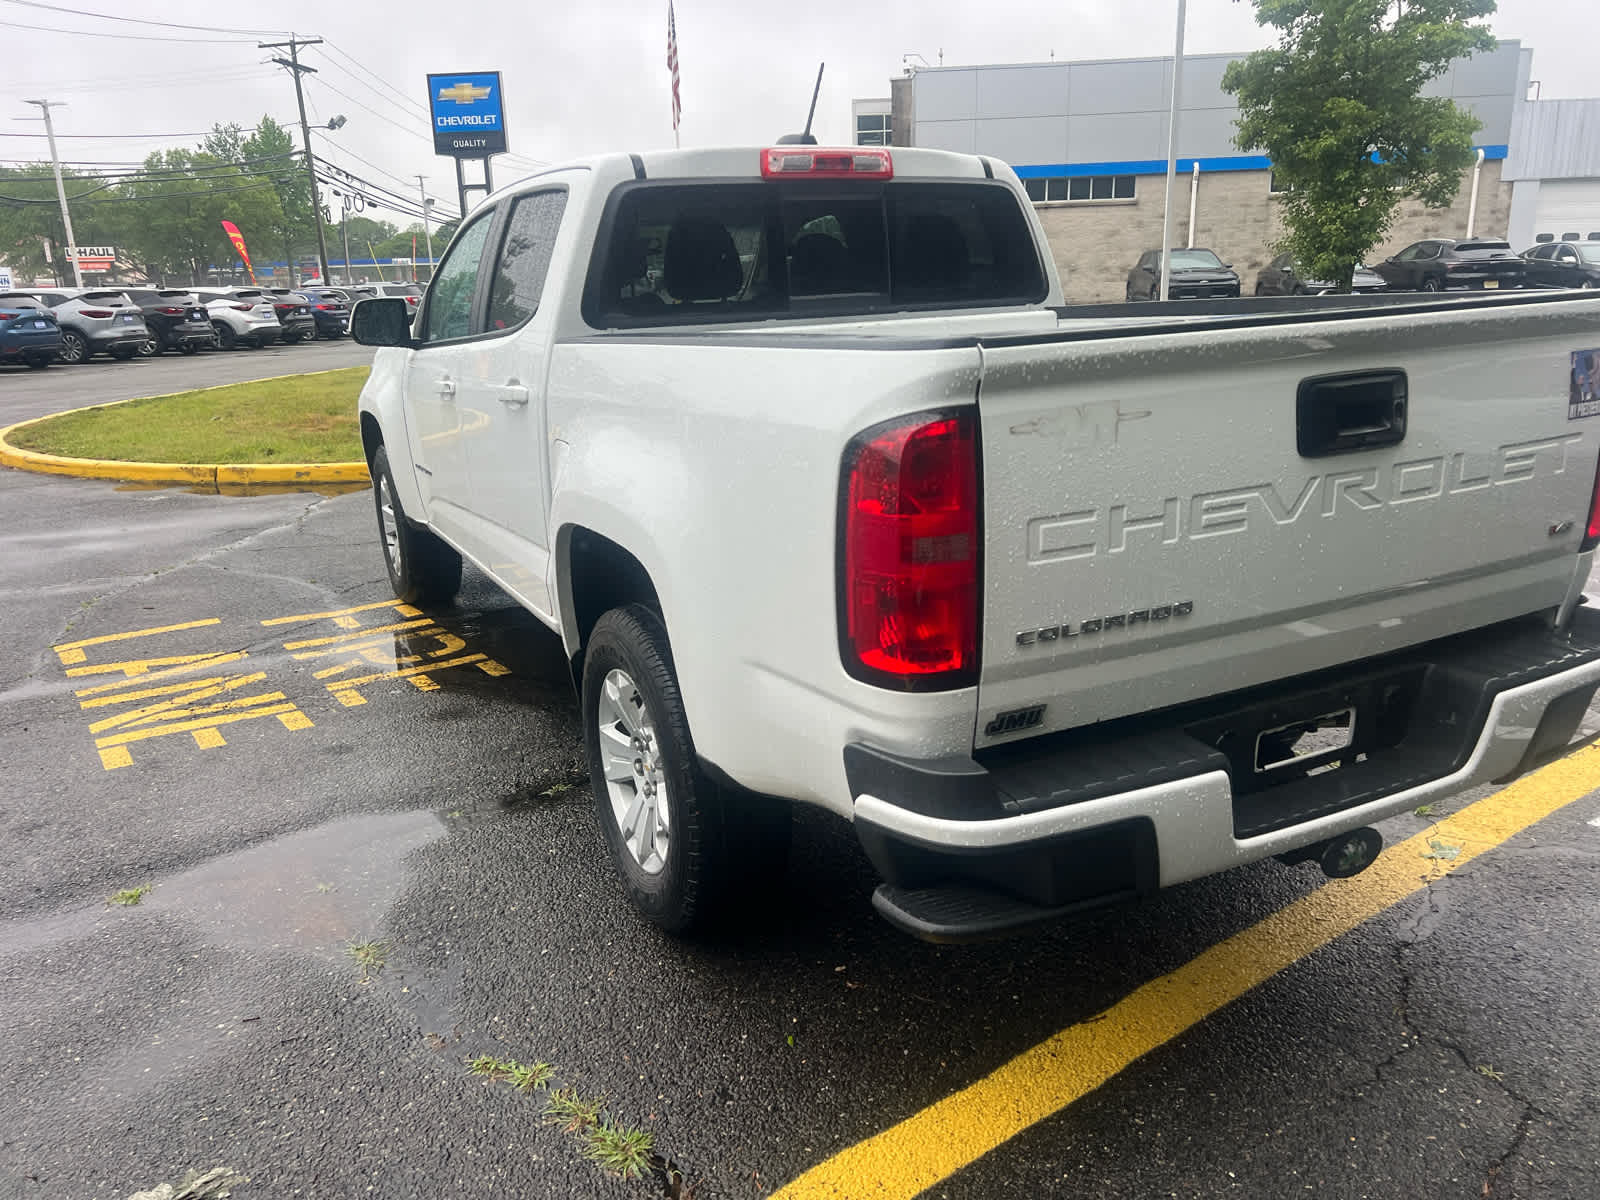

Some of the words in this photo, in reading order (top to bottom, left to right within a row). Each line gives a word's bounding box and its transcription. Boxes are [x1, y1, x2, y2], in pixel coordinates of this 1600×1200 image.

[437, 115, 496, 126] CHEVROLET
[453, 139, 486, 148] QUALITY
[1027, 432, 1583, 566] CHEVROLET
[260, 598, 512, 708] FIRE
[1016, 600, 1193, 646] COLORADO
[53, 617, 315, 771] LANE
